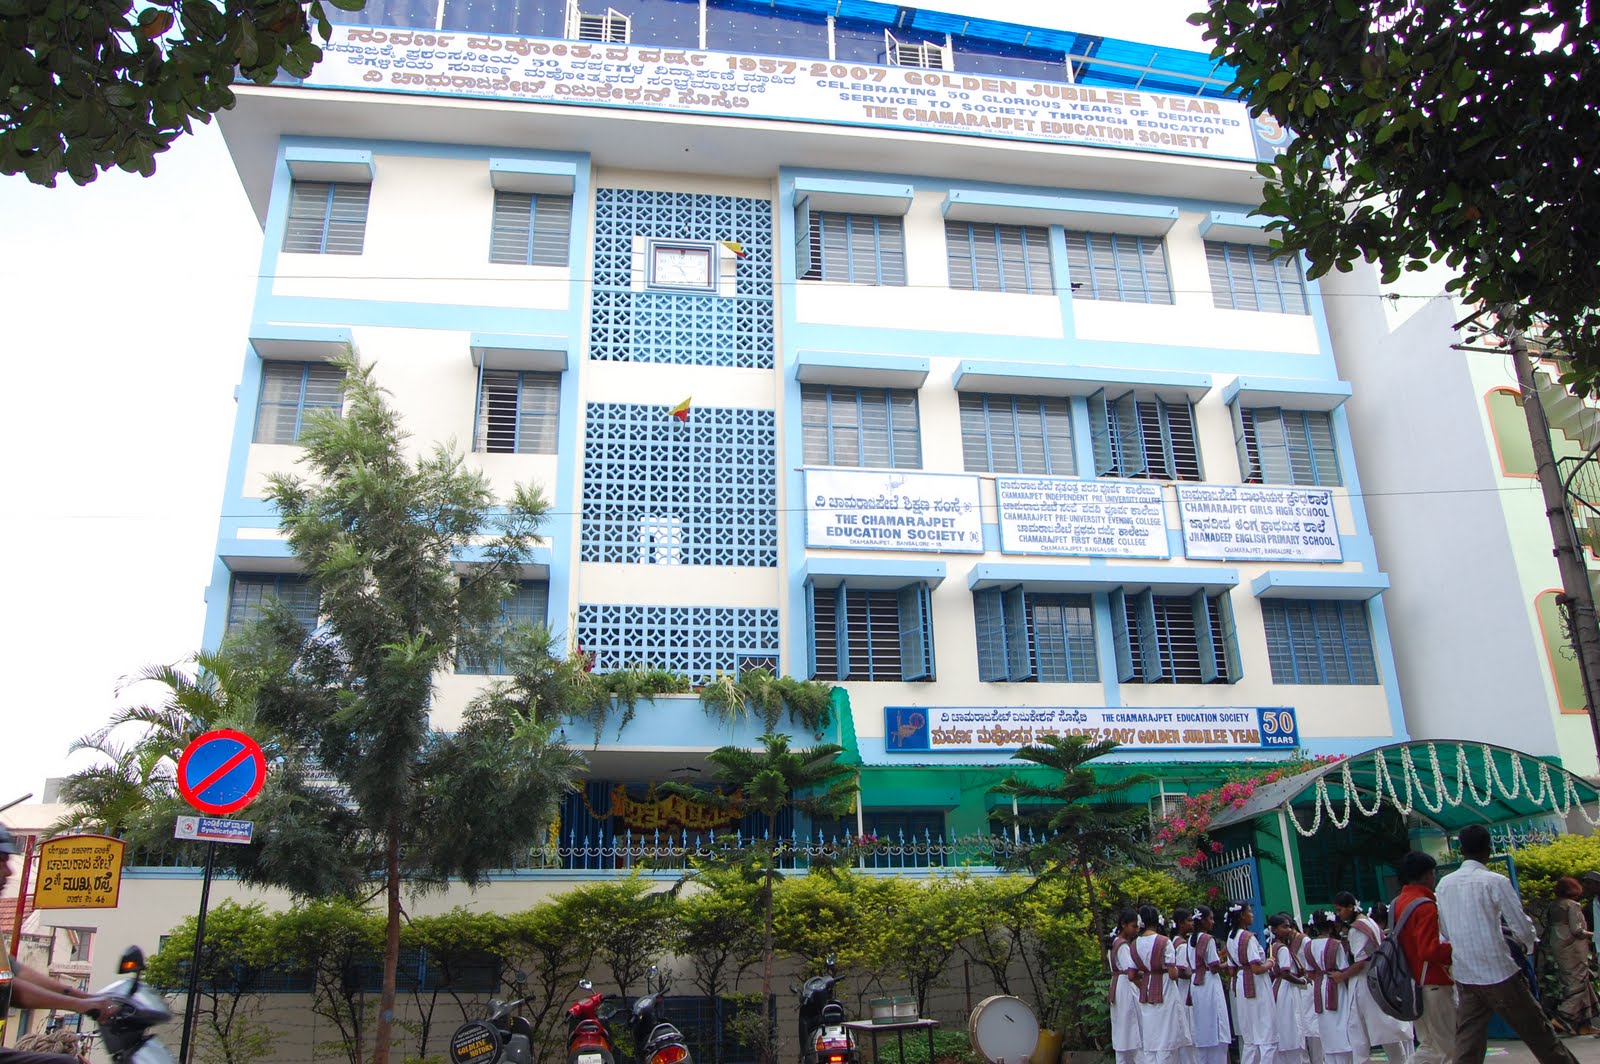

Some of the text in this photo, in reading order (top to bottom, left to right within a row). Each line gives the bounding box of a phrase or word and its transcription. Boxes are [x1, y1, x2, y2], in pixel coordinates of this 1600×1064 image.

[532, 58, 559, 68] 50
[347, 28, 1221, 115] ಸುವರ್ಣ ಮಹೋತ್ಸವ ವರ್ಷ 1957-2007 GOLDEN JUBILEE YEAR
[448, 62, 513, 75] ಸುವರ್ಣ
[524, 66, 635, 84] ಮಹೋತ್ಸವದ
[391, 70, 547, 94] ಚಾಮರಾಜಪೇಟ್
[554, 82, 671, 102] ಎಜುಕೇಶನ್
[816, 79, 1240, 127] CELEBRATING 50 GLORIOUS YEARS OF DEDICATED
[839, 92, 1225, 135] SERVICE TO SOCIETY THROUGH EDUCATION
[863, 104, 1210, 149] THE CHAMARAJPET EDUCATION SOCIETY
[1001, 491, 1161, 504] CHAMARAJPET INDEPENDENT PRE UNIVERSITY COLLEGE
[1184, 503, 1330, 517] CHAMARAJPET GIRLS HIGH SCHOOL
[835, 514, 956, 528] THE CHAMARAJPET
[1003, 512, 1052, 521] CHAMARAJPET
[1108, 516, 1133, 525] EVENING
[1136, 517, 1161, 526] COLLEGE
[826, 526, 901, 539] EDUCATION
[907, 529, 965, 542] SOCIETY
[1018, 535, 1146, 547] CHAMARAJPET FIRST GRADE COLLEGE
[1188, 532, 1336, 546] JNANADEEP ENGLISH PRIMARY SCHOOL
[940, 711, 950, 722] ದಿ
[951, 709, 1012, 722] ಚಾಮರಾಜಪೇಟ್
[1012, 710, 1056, 723] ಎಜುಕೇಶನ್
[1101, 713, 1115, 722] THE
[1115, 713, 1173, 723] CHAMARAJPET
[1176, 713, 1218, 723] EDUCATION
[1219, 713, 1249, 723] SOCIETY
[1263, 711, 1294, 734] 50
[931, 725, 973, 745] ಸುವರ್ಣ
[1137, 728, 1180, 744] GOLDEN
[1183, 728, 1228, 744] JUBILEE
[1228, 729, 1261, 744] YEAR
[1266, 736, 1294, 744] YEARS
[201, 826, 249, 836] SyndicateBank
[457, 1039, 487, 1055] GOLDLINE
[470, 1043, 494, 1057] MOTORS
